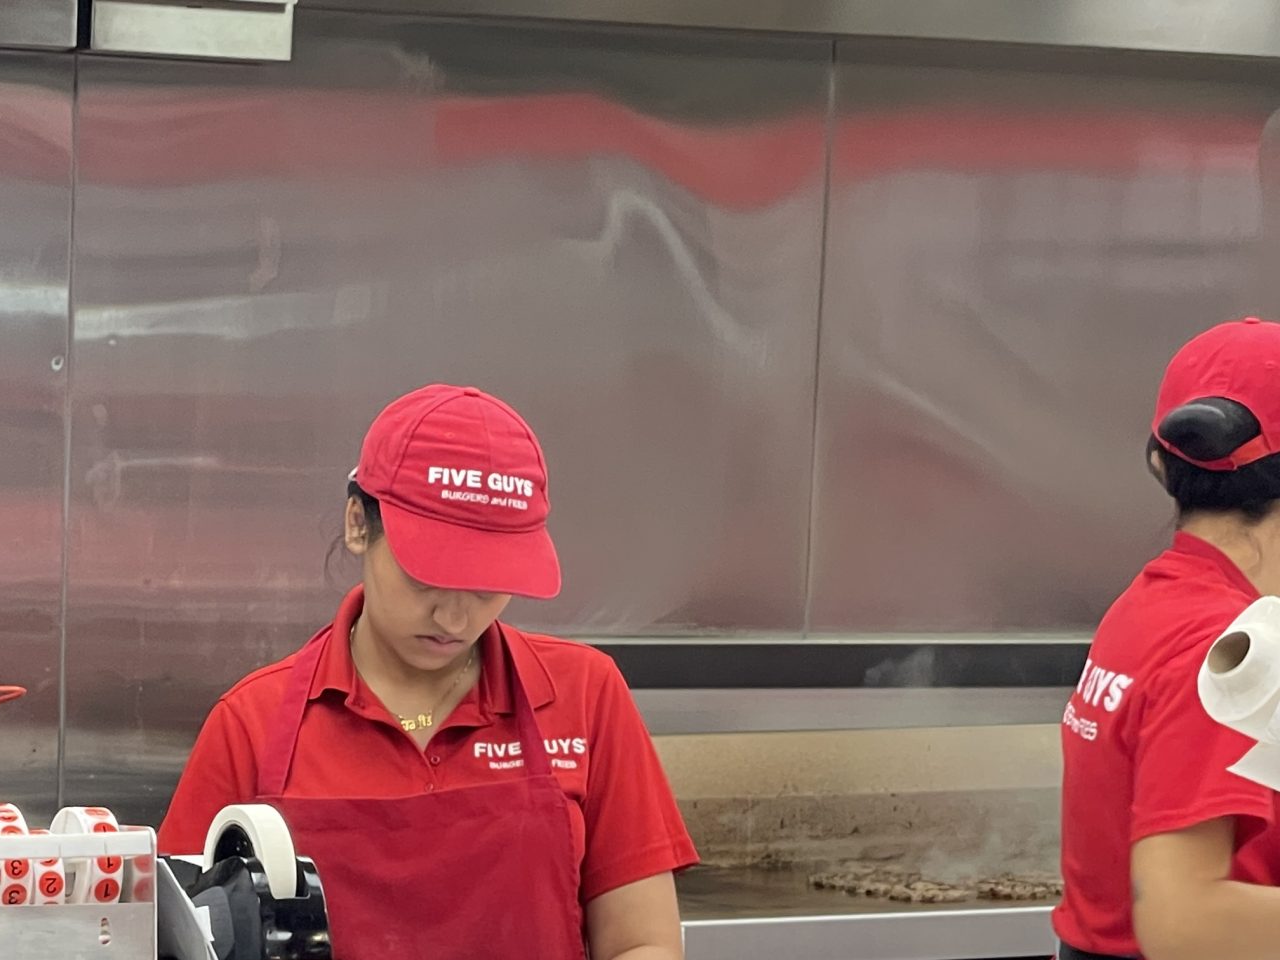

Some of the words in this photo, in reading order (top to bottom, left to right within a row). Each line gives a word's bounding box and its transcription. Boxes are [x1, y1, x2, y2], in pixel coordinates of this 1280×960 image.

[428, 466, 482, 488] FIVE
[487, 472, 534, 497] GUYS
[474, 741, 522, 758] FIVE
[543, 738, 586, 755] UYS
